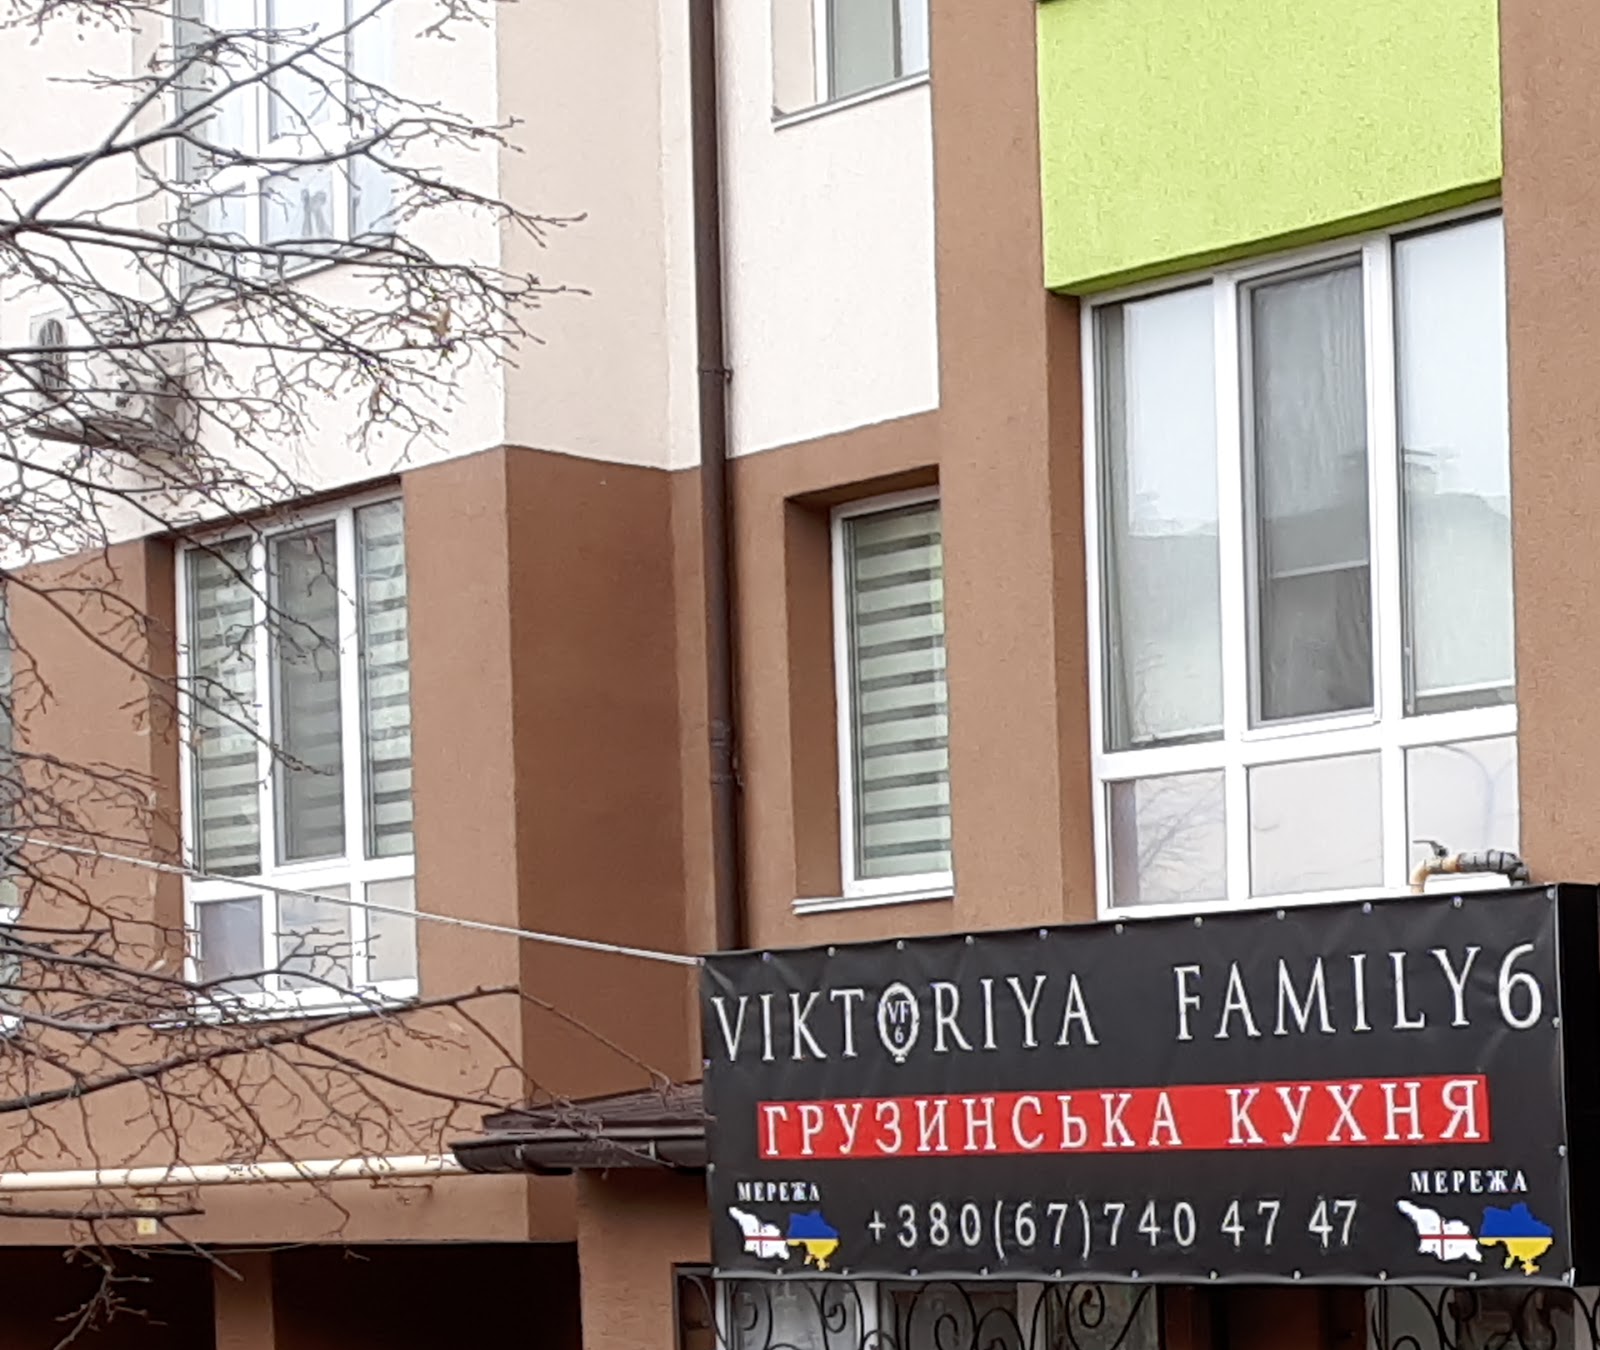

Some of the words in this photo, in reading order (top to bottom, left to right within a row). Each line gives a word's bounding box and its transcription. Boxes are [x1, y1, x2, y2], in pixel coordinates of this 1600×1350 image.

[711, 973, 1100, 1063] VIKTORIYA
[763, 1091, 1182, 1156] ГРУЗИНСЬКА
[1225, 1079, 1481, 1144] КУХНЯ
[737, 1181, 821, 1202] МЕРЕЖА
[1410, 1169, 1528, 1193] МЕРЕЖА
[1220, 1200, 1281, 1247] 47
[1308, 1199, 1358, 1248] 47
